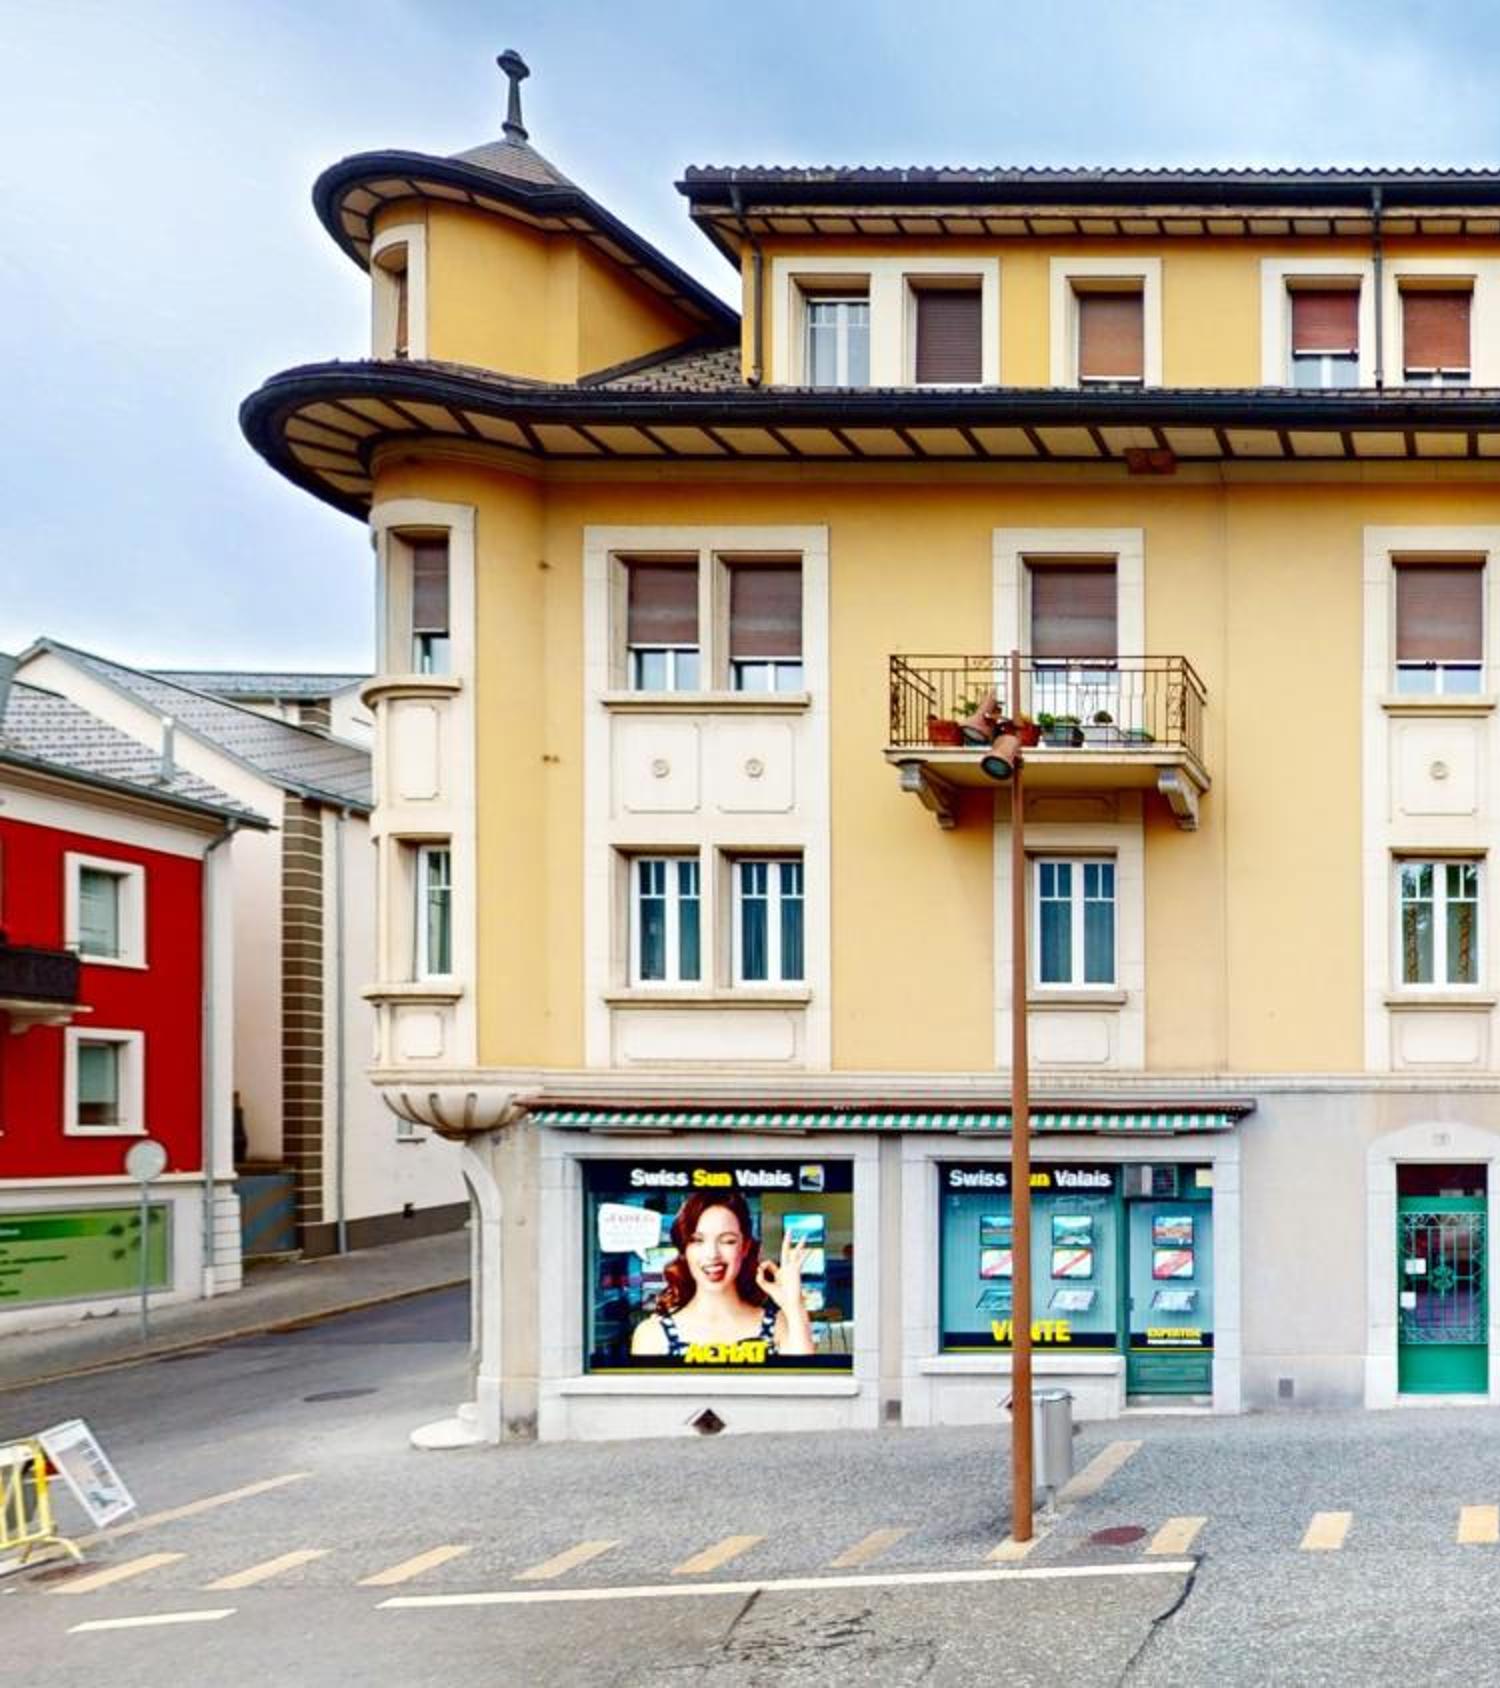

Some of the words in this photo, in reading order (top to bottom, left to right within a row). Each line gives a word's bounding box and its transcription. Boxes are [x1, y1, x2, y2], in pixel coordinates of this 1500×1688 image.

[630, 1168, 688, 1187] Swiss
[692, 1168, 732, 1187] Sun
[735, 1168, 794, 1187] Valais
[949, 1168, 1008, 1187] Swiss
[1053, 1168, 1113, 1188] Valais
[683, 1341, 768, 1364] ACHAT
